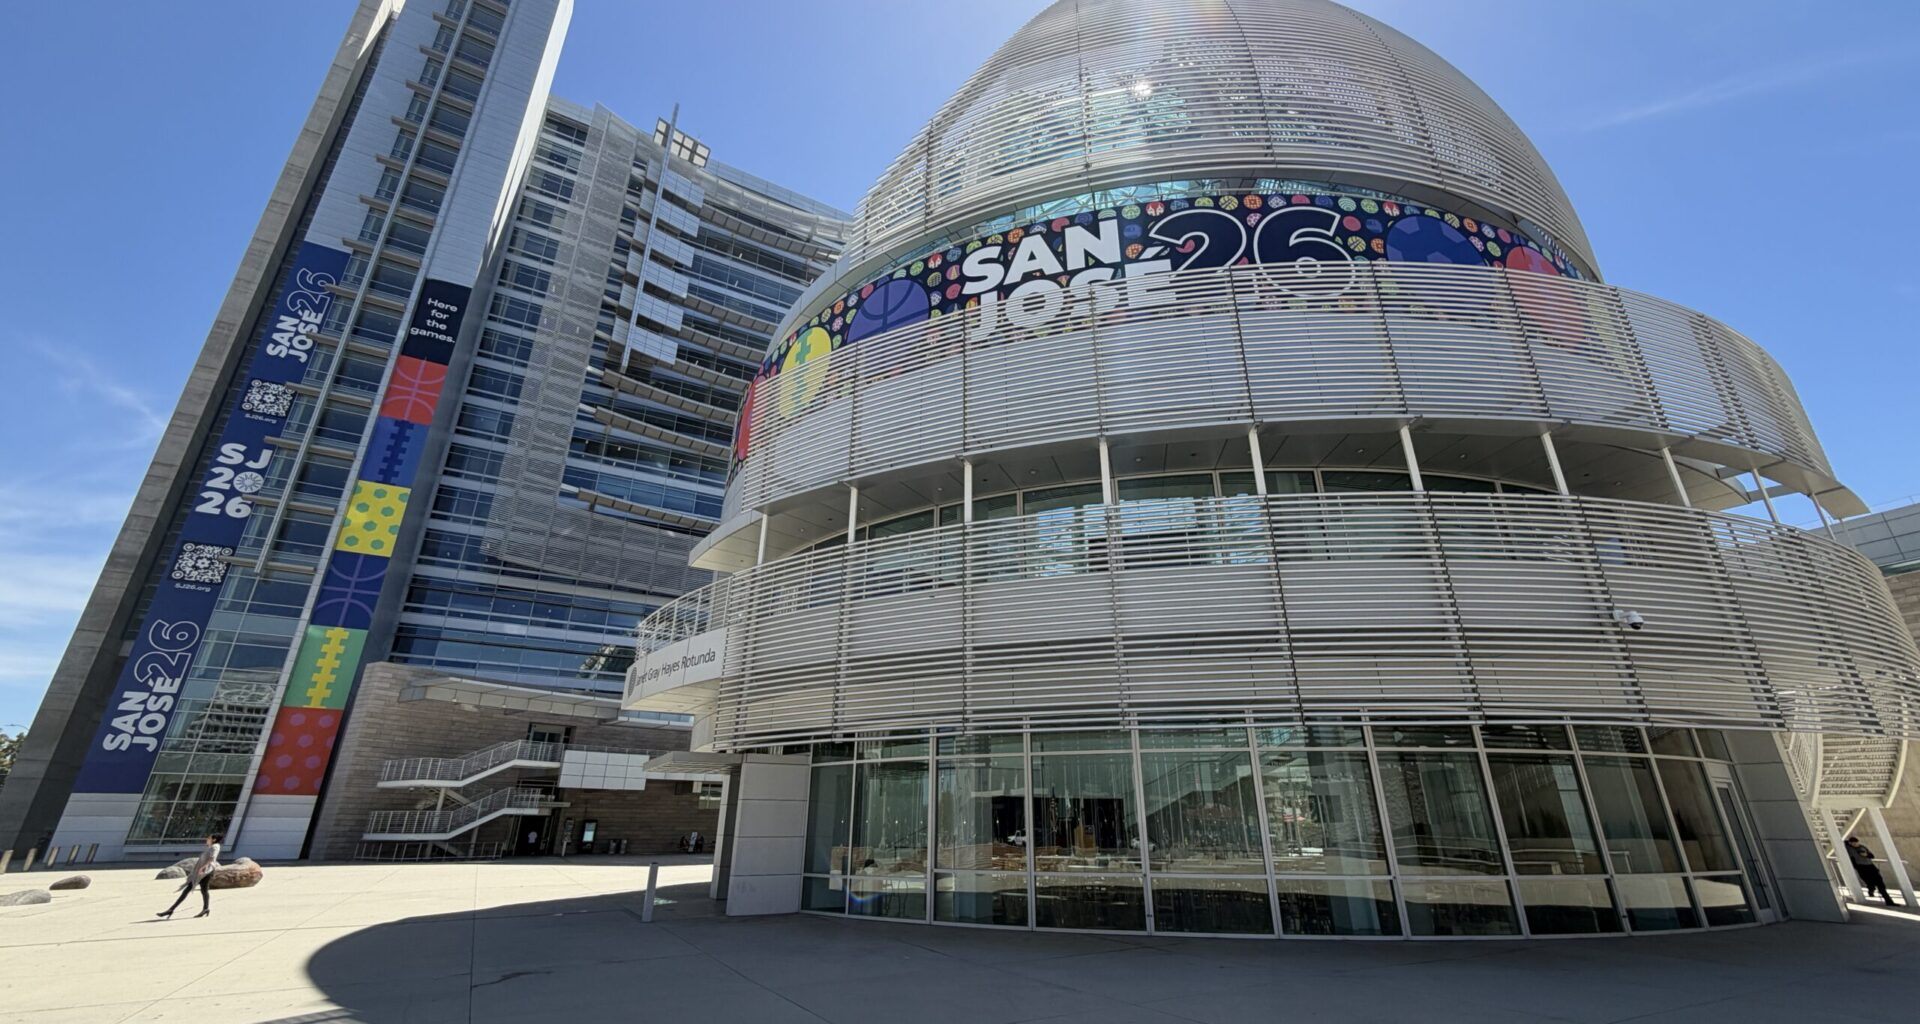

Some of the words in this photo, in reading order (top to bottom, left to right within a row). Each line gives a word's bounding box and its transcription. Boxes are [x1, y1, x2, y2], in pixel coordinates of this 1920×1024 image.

[962, 218, 1121, 295] SAN
[1148, 205, 1357, 300] 26
[286, 267, 336, 314] 26
[427, 297, 458, 312] Here
[970, 245, 1177, 343] JOSÉ
[266, 314, 301, 358] SAN
[287, 309, 323, 363] JOSÉ
[410, 327, 456, 344] games.
[426, 319, 447, 330] the
[431, 309, 450, 320] for
[216, 442, 273, 469] SJ
[195, 490, 252, 519] 26
[134, 619, 200, 683] 26
[660, 660, 680, 677] Hayes
[680, 647, 716, 669] Rotunda
[102, 691, 150, 751] SAN
[131, 676, 182, 752] JOSÉ
